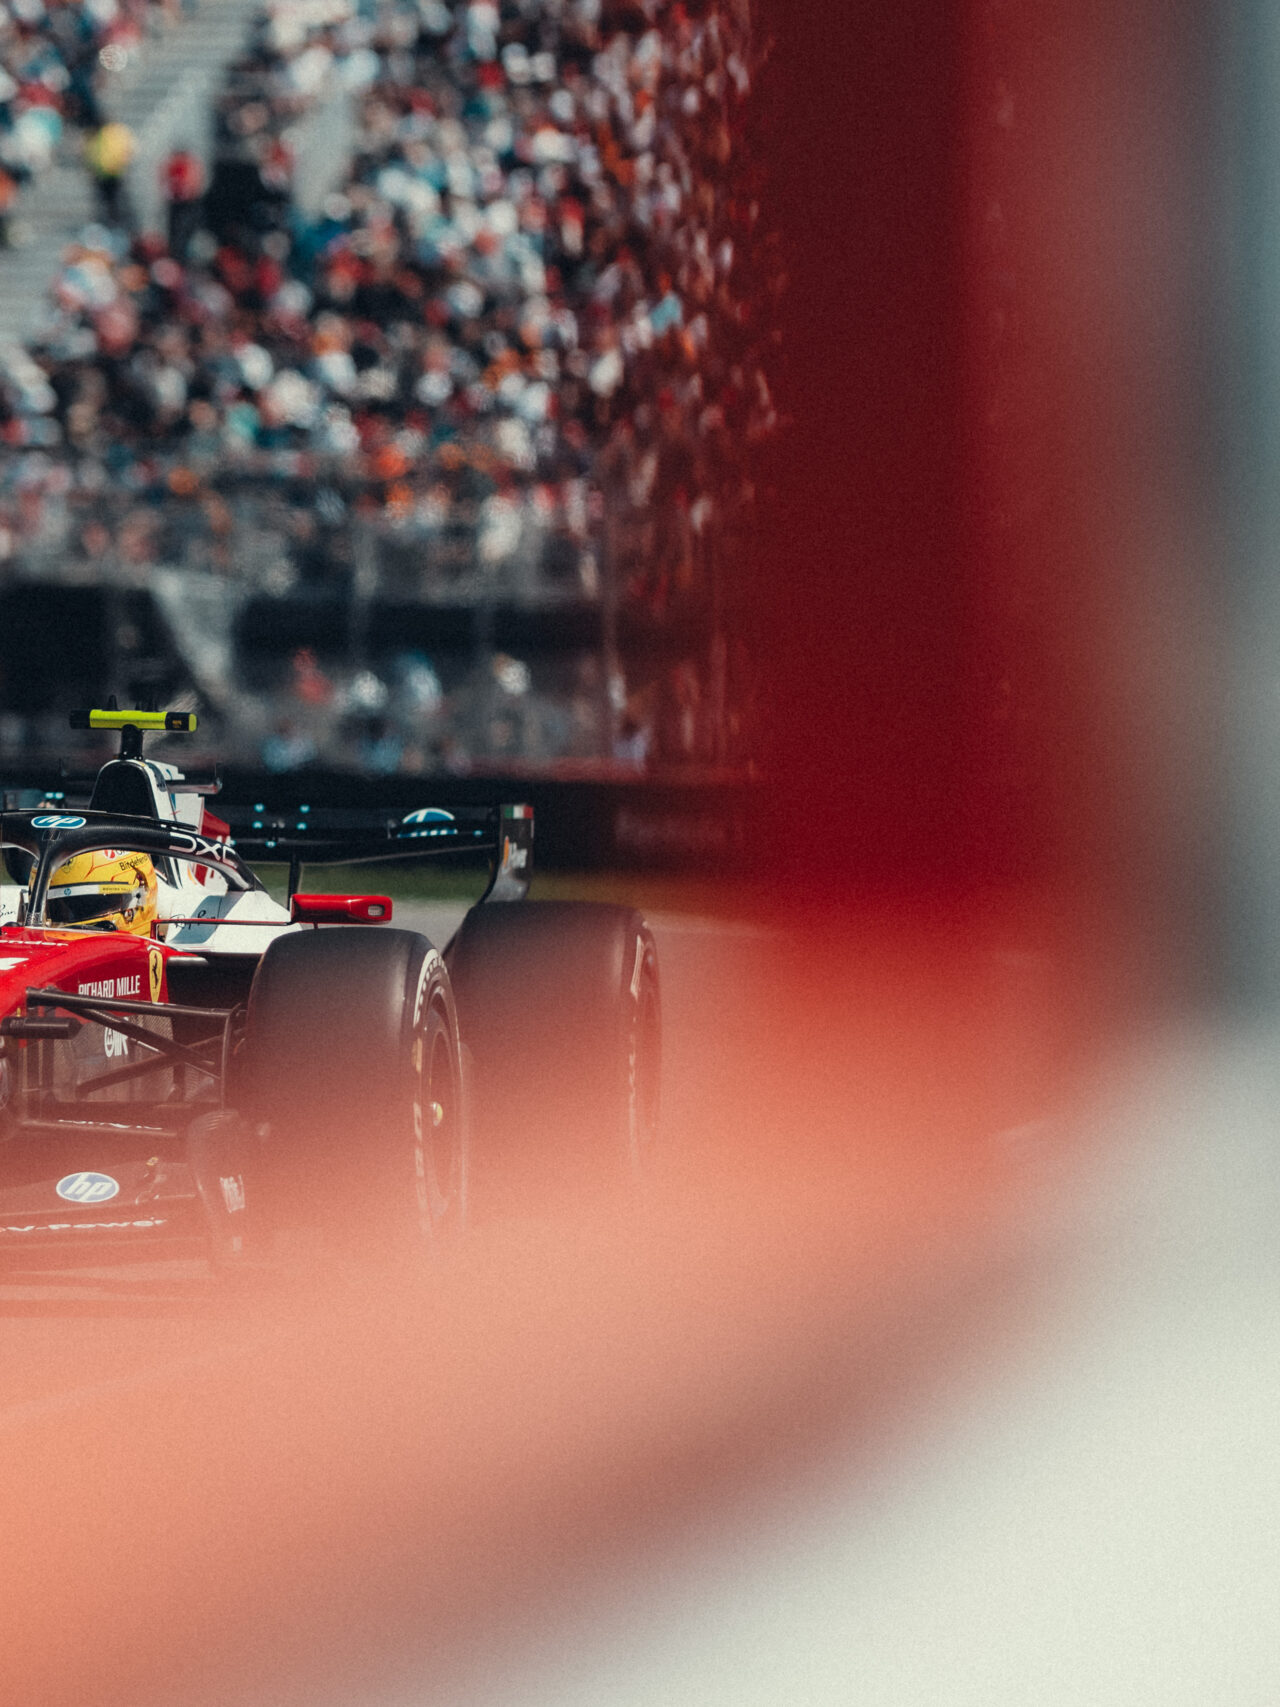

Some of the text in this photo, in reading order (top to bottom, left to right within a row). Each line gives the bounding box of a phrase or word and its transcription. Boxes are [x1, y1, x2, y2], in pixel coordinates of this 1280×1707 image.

[37, 815, 81, 829] hp
[169, 831, 238, 869] DXC
[78, 974, 140, 998] RICHARD MILLE
[63, 1172, 113, 1202] hp
